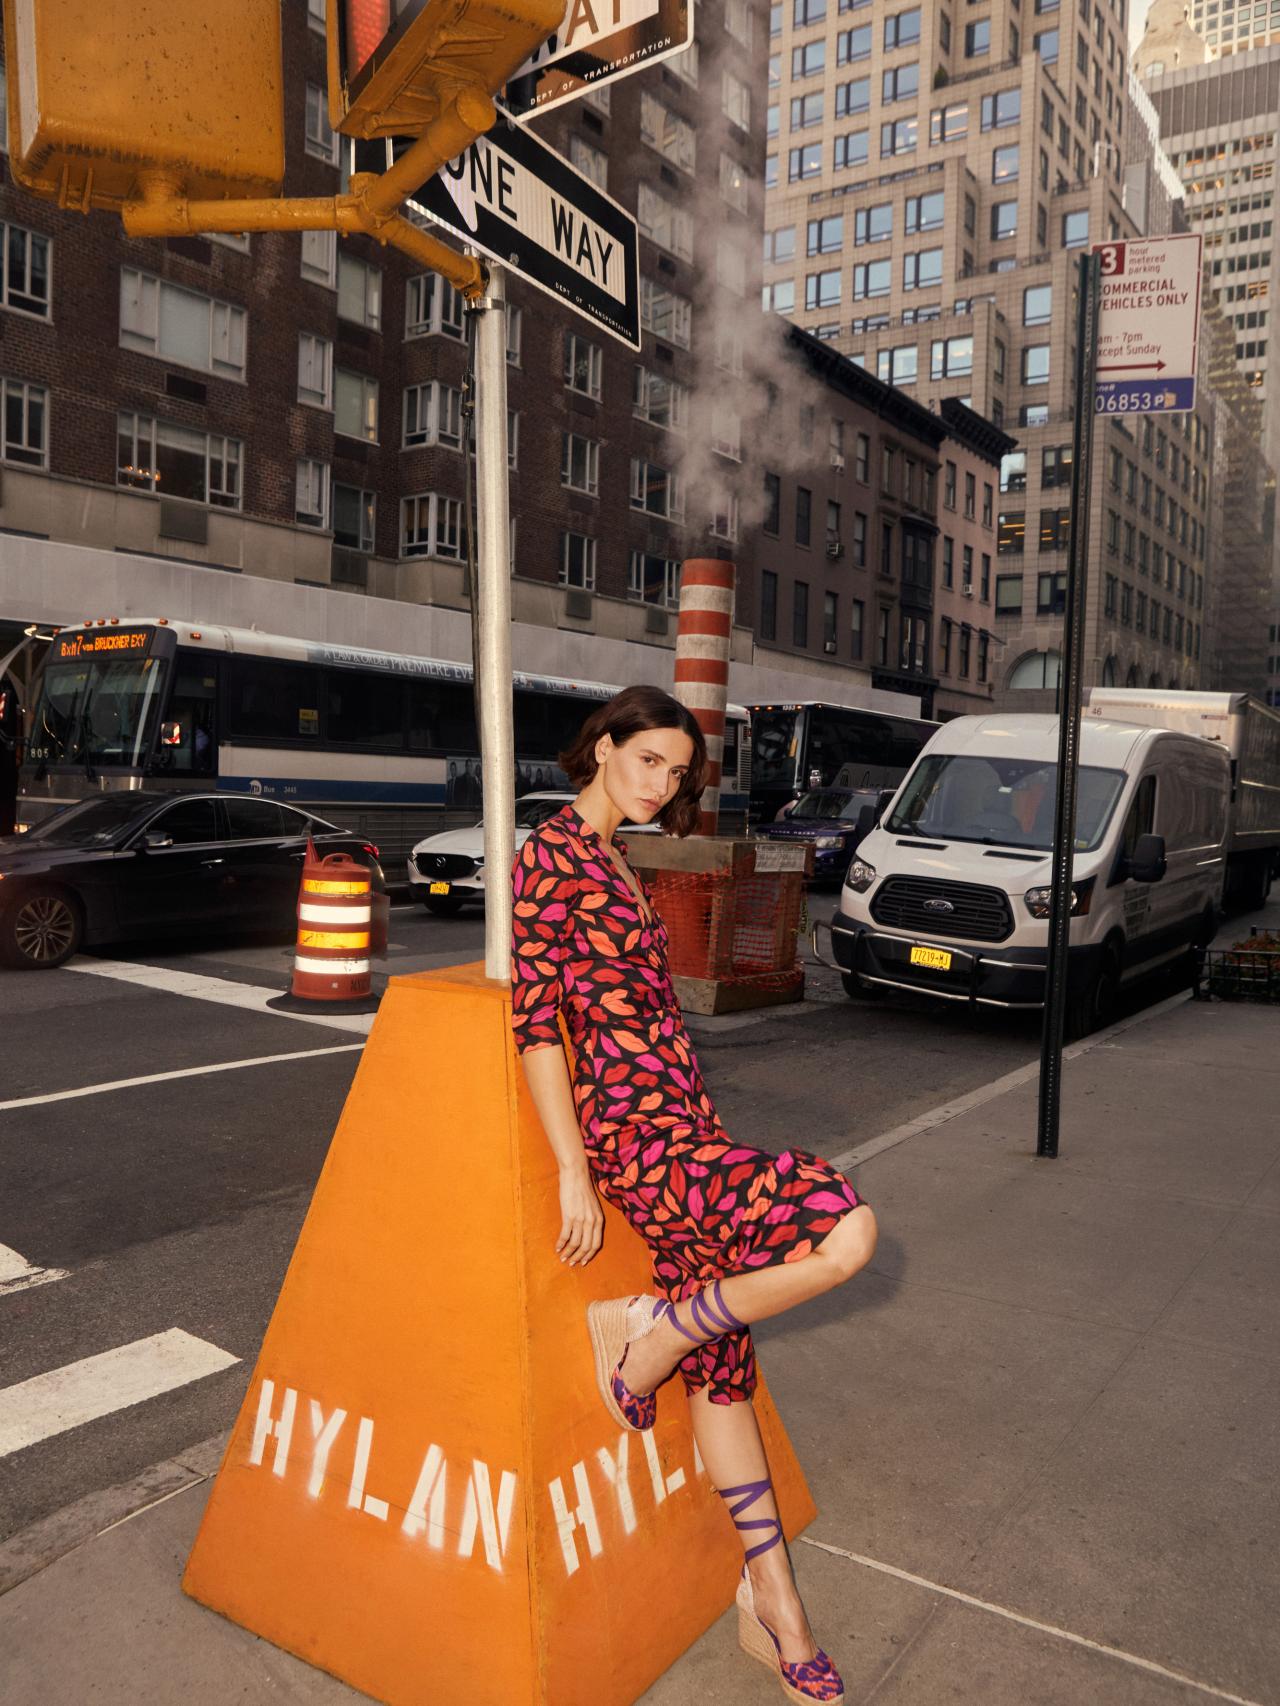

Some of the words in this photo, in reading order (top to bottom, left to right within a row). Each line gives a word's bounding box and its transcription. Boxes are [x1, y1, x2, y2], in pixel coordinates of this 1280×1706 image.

[530, 90, 553, 106] DEPT
[562, 81, 574, 91] OF
[584, 37, 671, 81] TRANSPORTATION
[551, 196, 613, 286] WAY
[1128, 254, 1166, 265] metered
[1129, 247, 1149, 256] hour
[1101, 246, 1117, 274] 3
[1128, 264, 1161, 275] parking
[1100, 278, 1176, 296] OMMERCIAL
[1156, 292, 1188, 306] ONLY
[555, 281, 570, 296] DEPT
[588, 304, 632, 337] TRANSPORTATION
[1097, 335, 1112, 344] am
[1122, 332, 1143, 343] 7pm
[1098, 346, 1123, 357] xcept
[1126, 344, 1161, 356] Sunday
[333, 650, 351, 661] LAW
[361, 654, 389, 666] ORDER
[390, 656, 451, 677] PREMIERE
[1092, 707, 1103, 716] 46
[249, 1378, 517, 1574] HYLAN
